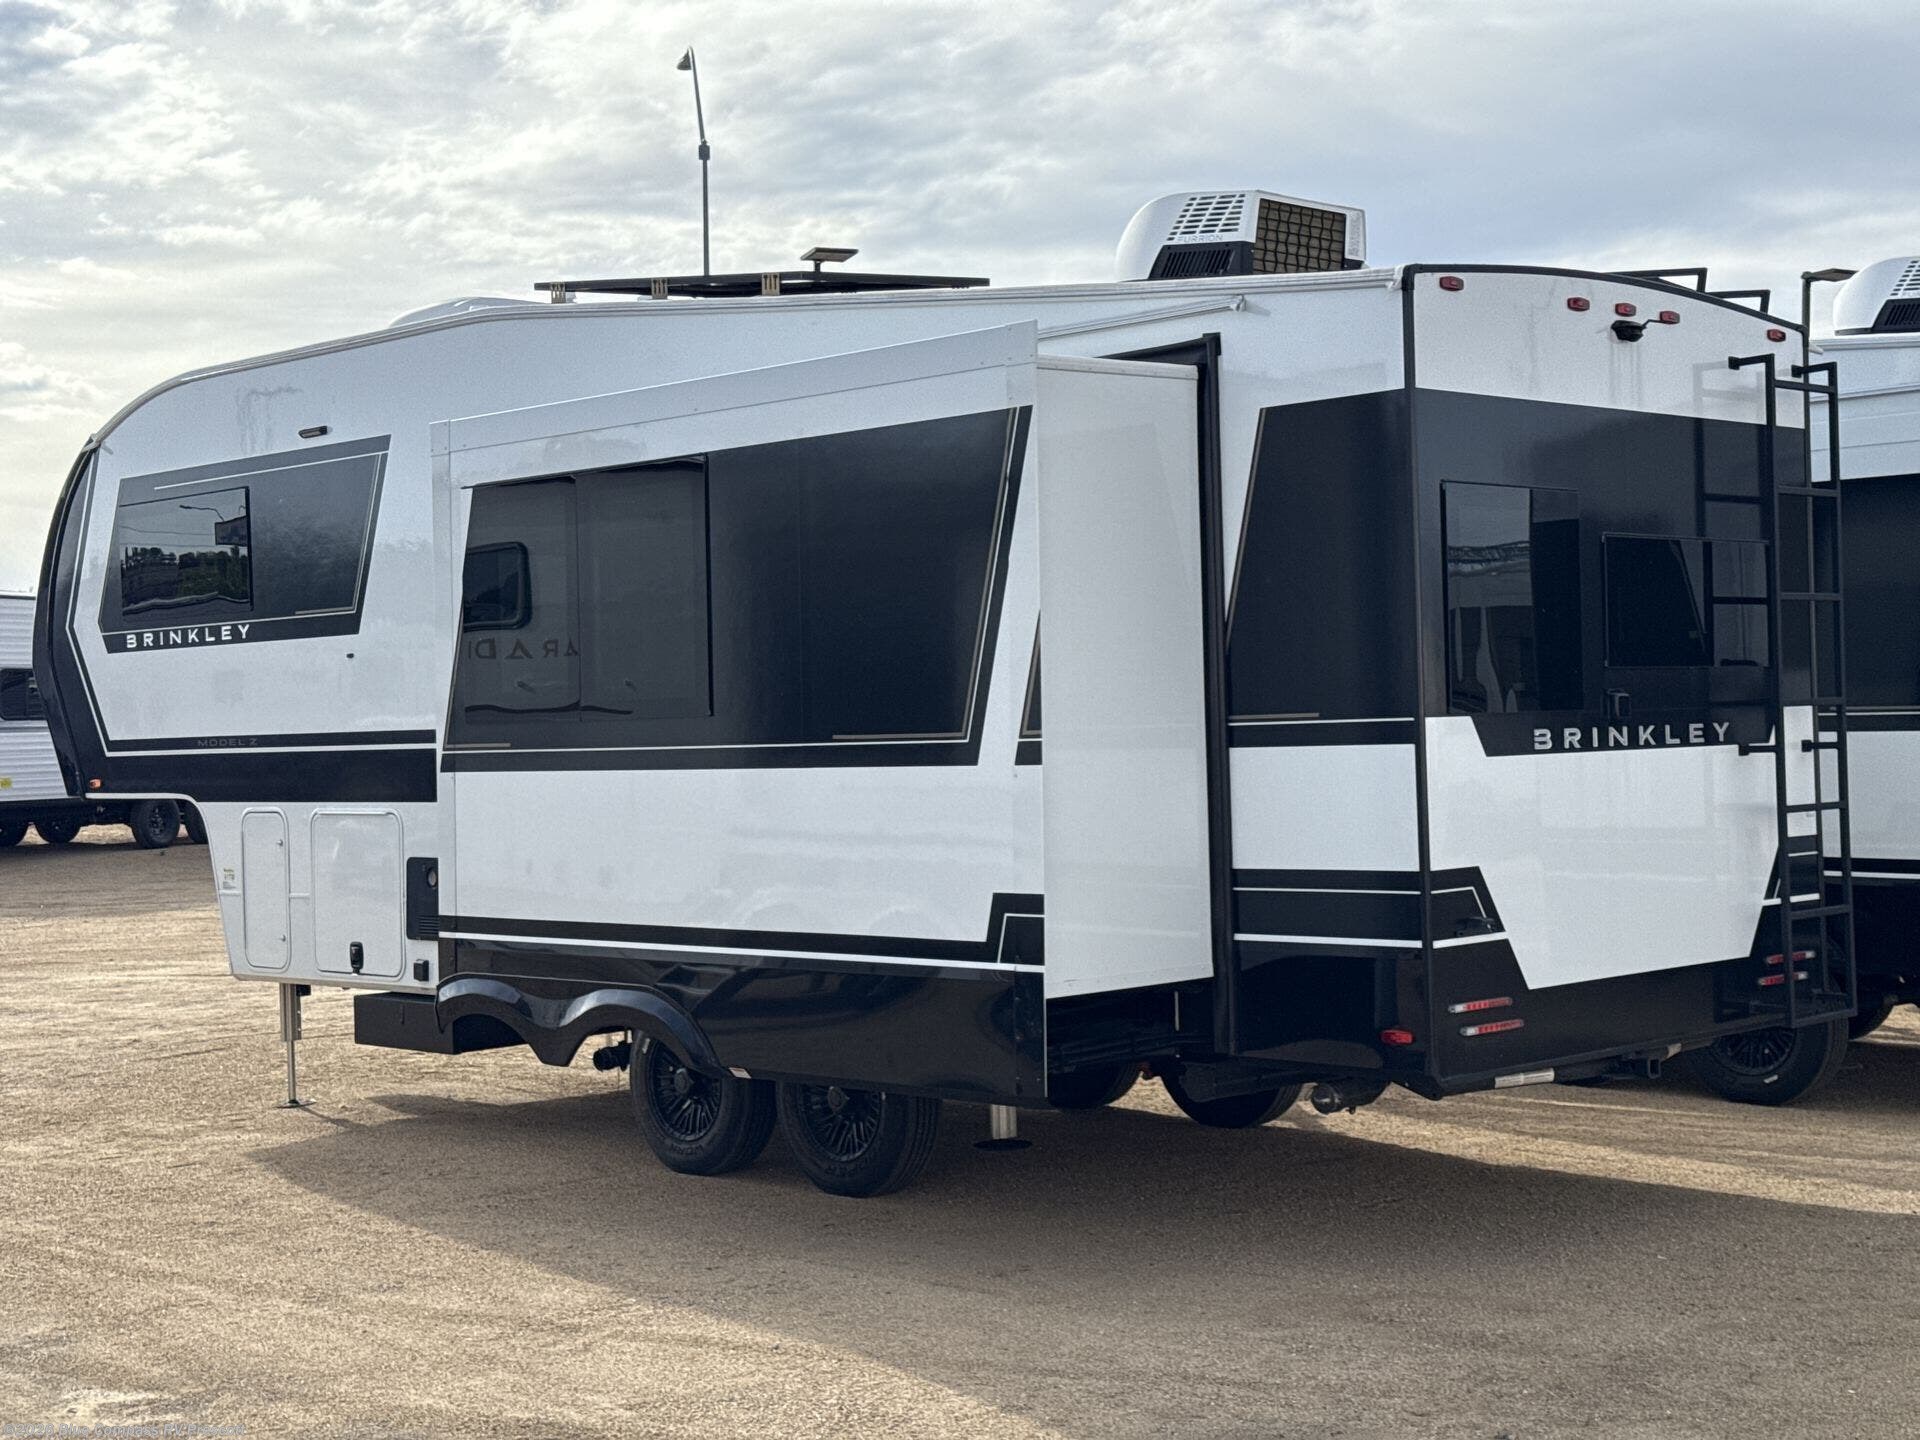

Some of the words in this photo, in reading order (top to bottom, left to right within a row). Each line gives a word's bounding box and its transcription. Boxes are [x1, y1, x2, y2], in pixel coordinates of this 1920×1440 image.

[126, 623, 250, 649] BRINKLEY
[197, 738, 246, 747] MODEL
[248, 737, 258, 746] Z
[1533, 721, 1730, 751] BRINKLEY
